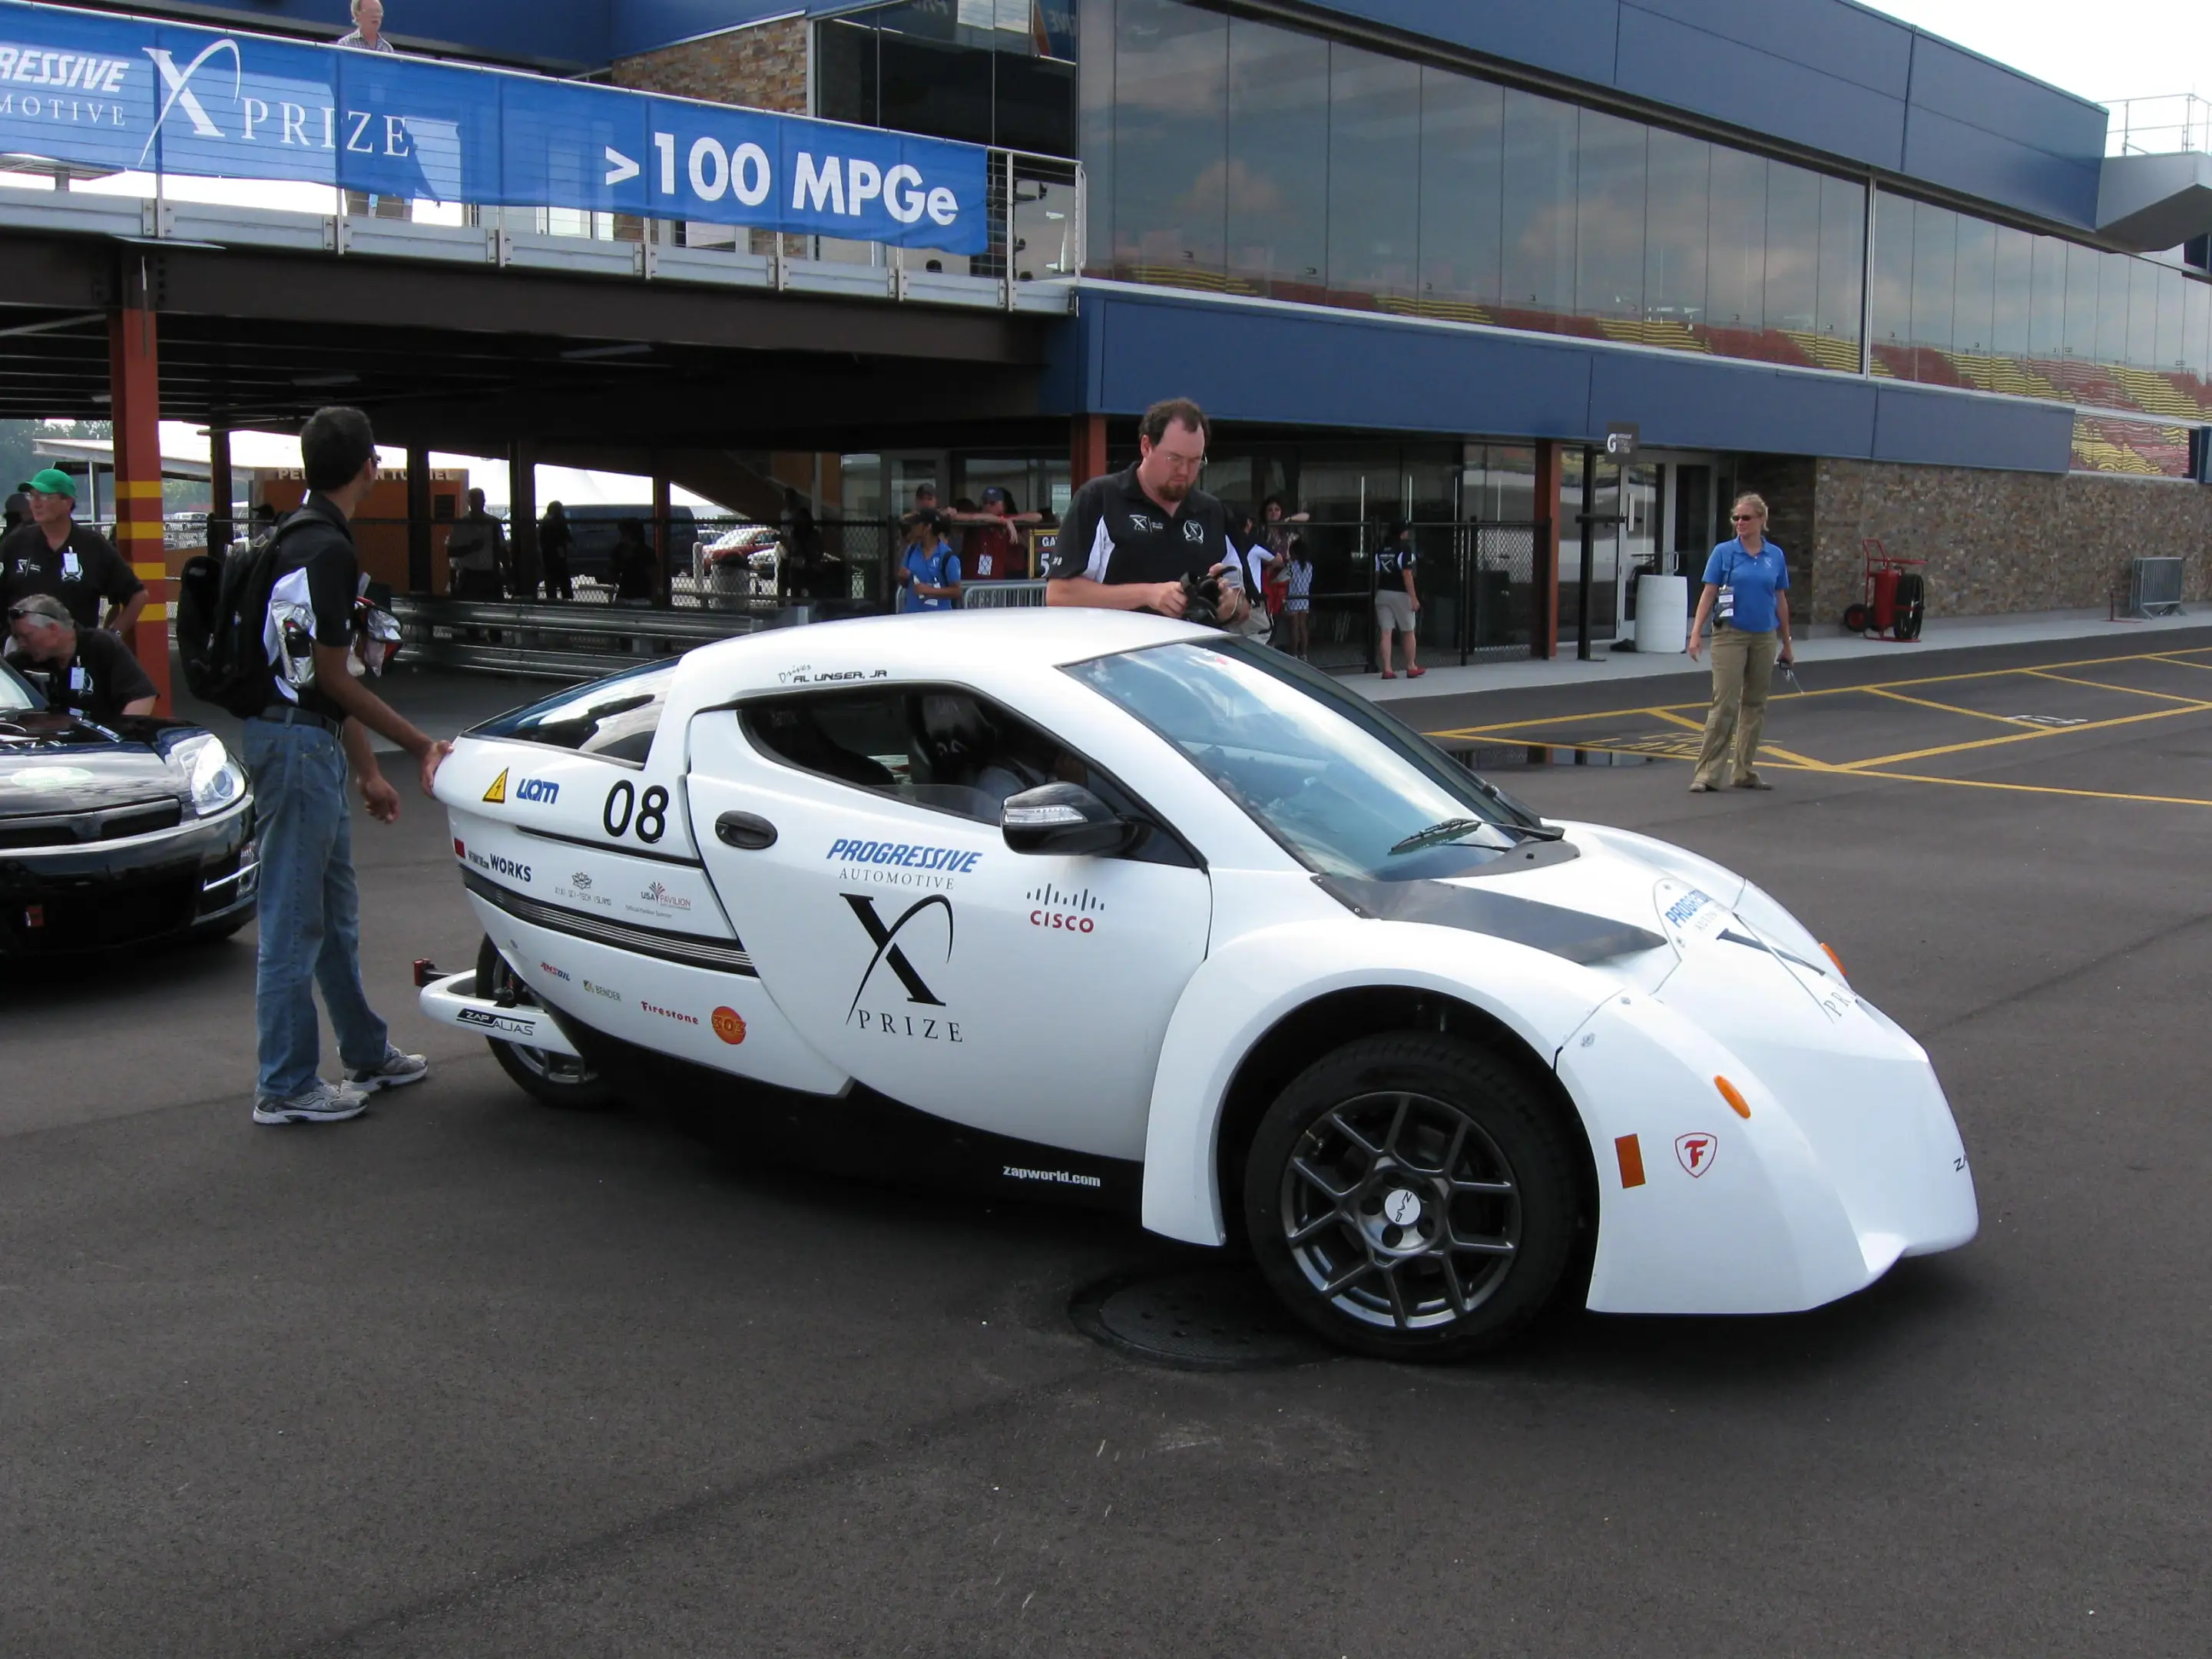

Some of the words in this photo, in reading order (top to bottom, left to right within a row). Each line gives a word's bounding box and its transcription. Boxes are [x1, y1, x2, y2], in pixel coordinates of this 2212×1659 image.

[137, 39, 241, 168] X
[241, 97, 410, 157] PRIZE
[792, 152, 959, 226] MPGe
[1041, 536, 1058, 547] GA
[793, 675, 810, 684] AL
[814, 671, 866, 682] UNSER,
[869, 670, 888, 678] JR
[603, 779, 670, 844] 08
[490, 853, 531, 882] WORKS
[826, 839, 983, 873] PROGRESSIVE
[839, 868, 955, 890] AUTOMOTIVE
[641, 891, 655, 901] USA
[661, 895, 691, 907] PAVILION
[1030, 909, 1094, 933] CISCO
[839, 892, 954, 1025] X
[541, 962, 570, 982] AMSOIL
[465, 1012, 490, 1022] ZAP
[493, 1020, 534, 1036] ALIAS
[641, 1000, 699, 1025] Firestone
[858, 1009, 963, 1043] PRIZE
[1002, 1165, 1101, 1187] zapworld.com
